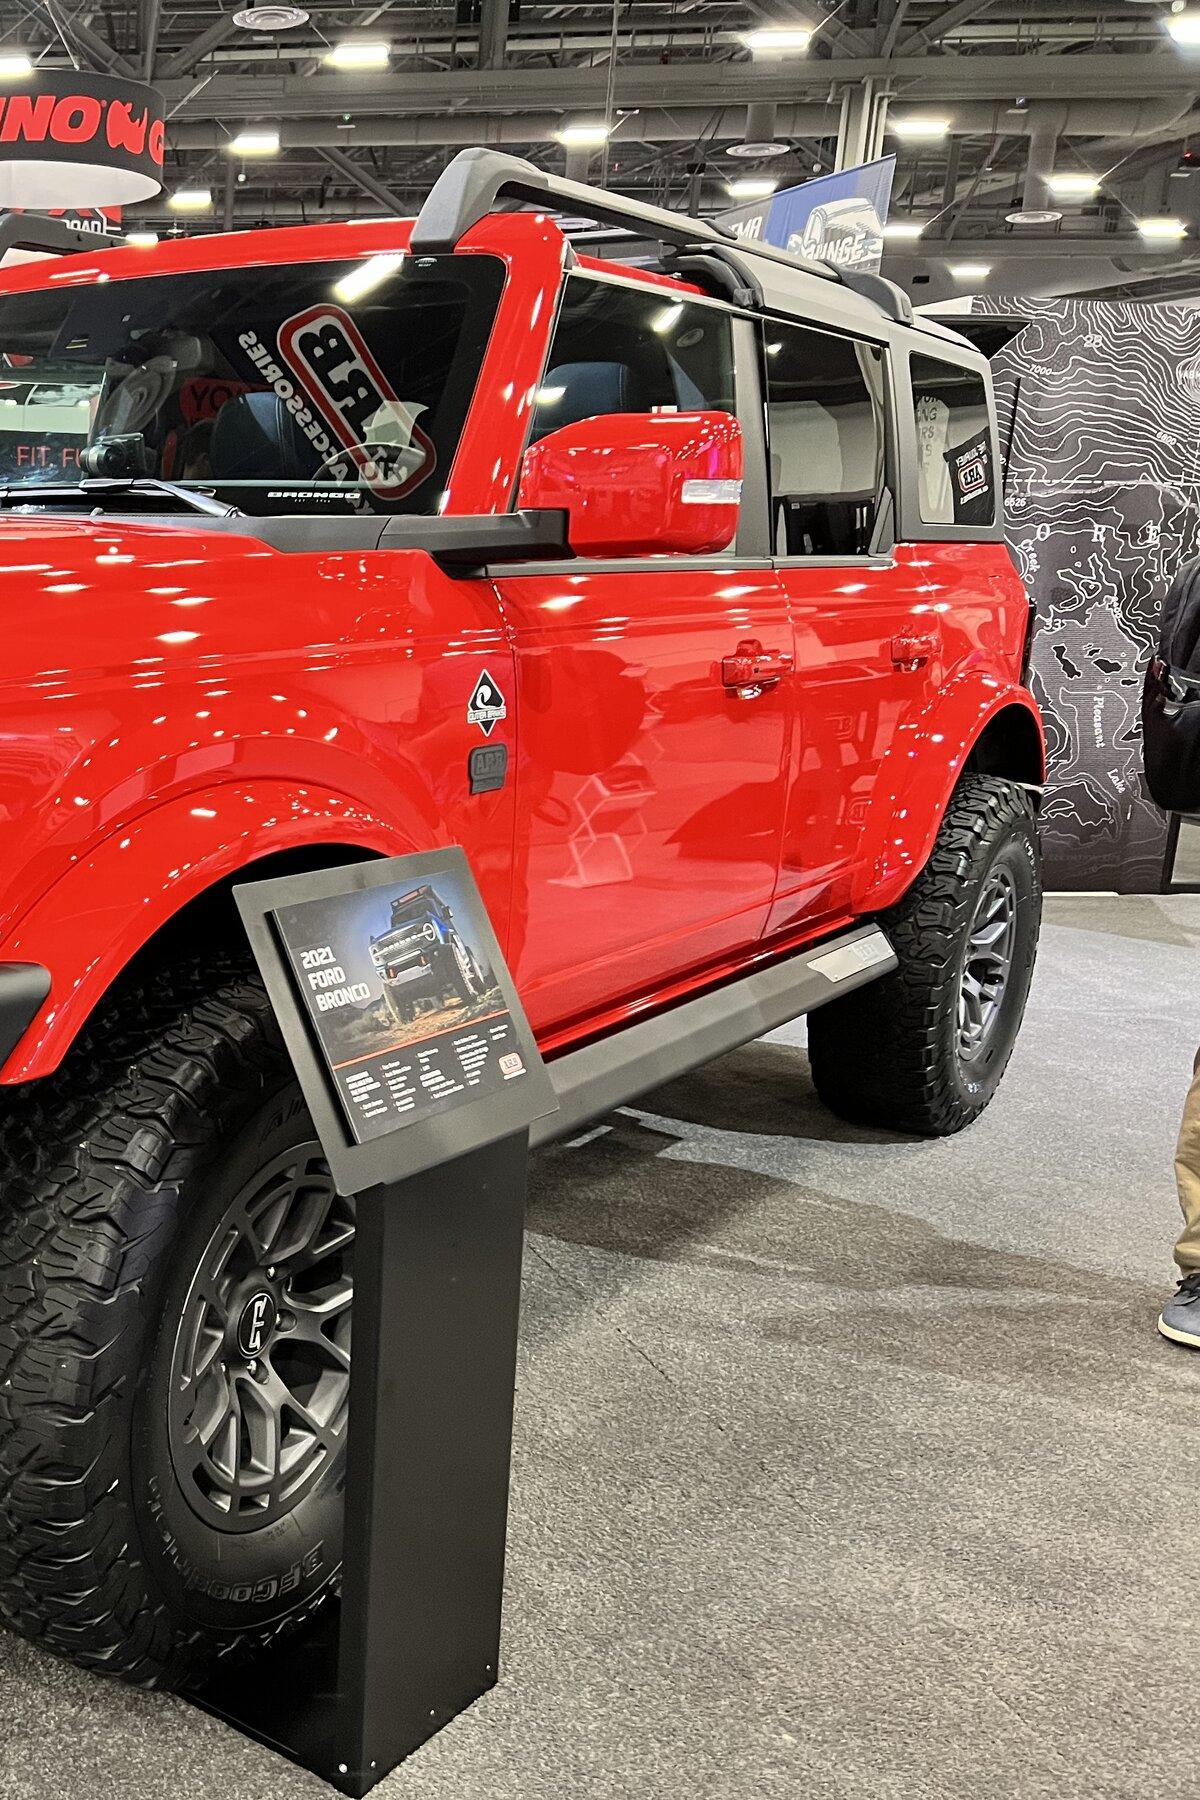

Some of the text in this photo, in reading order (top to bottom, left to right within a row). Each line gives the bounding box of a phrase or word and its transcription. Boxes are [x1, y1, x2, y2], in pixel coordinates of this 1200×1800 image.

[1029, 363, 1053, 376] 7000
[1093, 696, 1106, 749] Pleasant
[1106, 767, 1127, 794] Lake
[299, 945, 337, 970] 2021
[307, 965, 347, 991] FORD
[315, 982, 371, 1012] BRONCO
